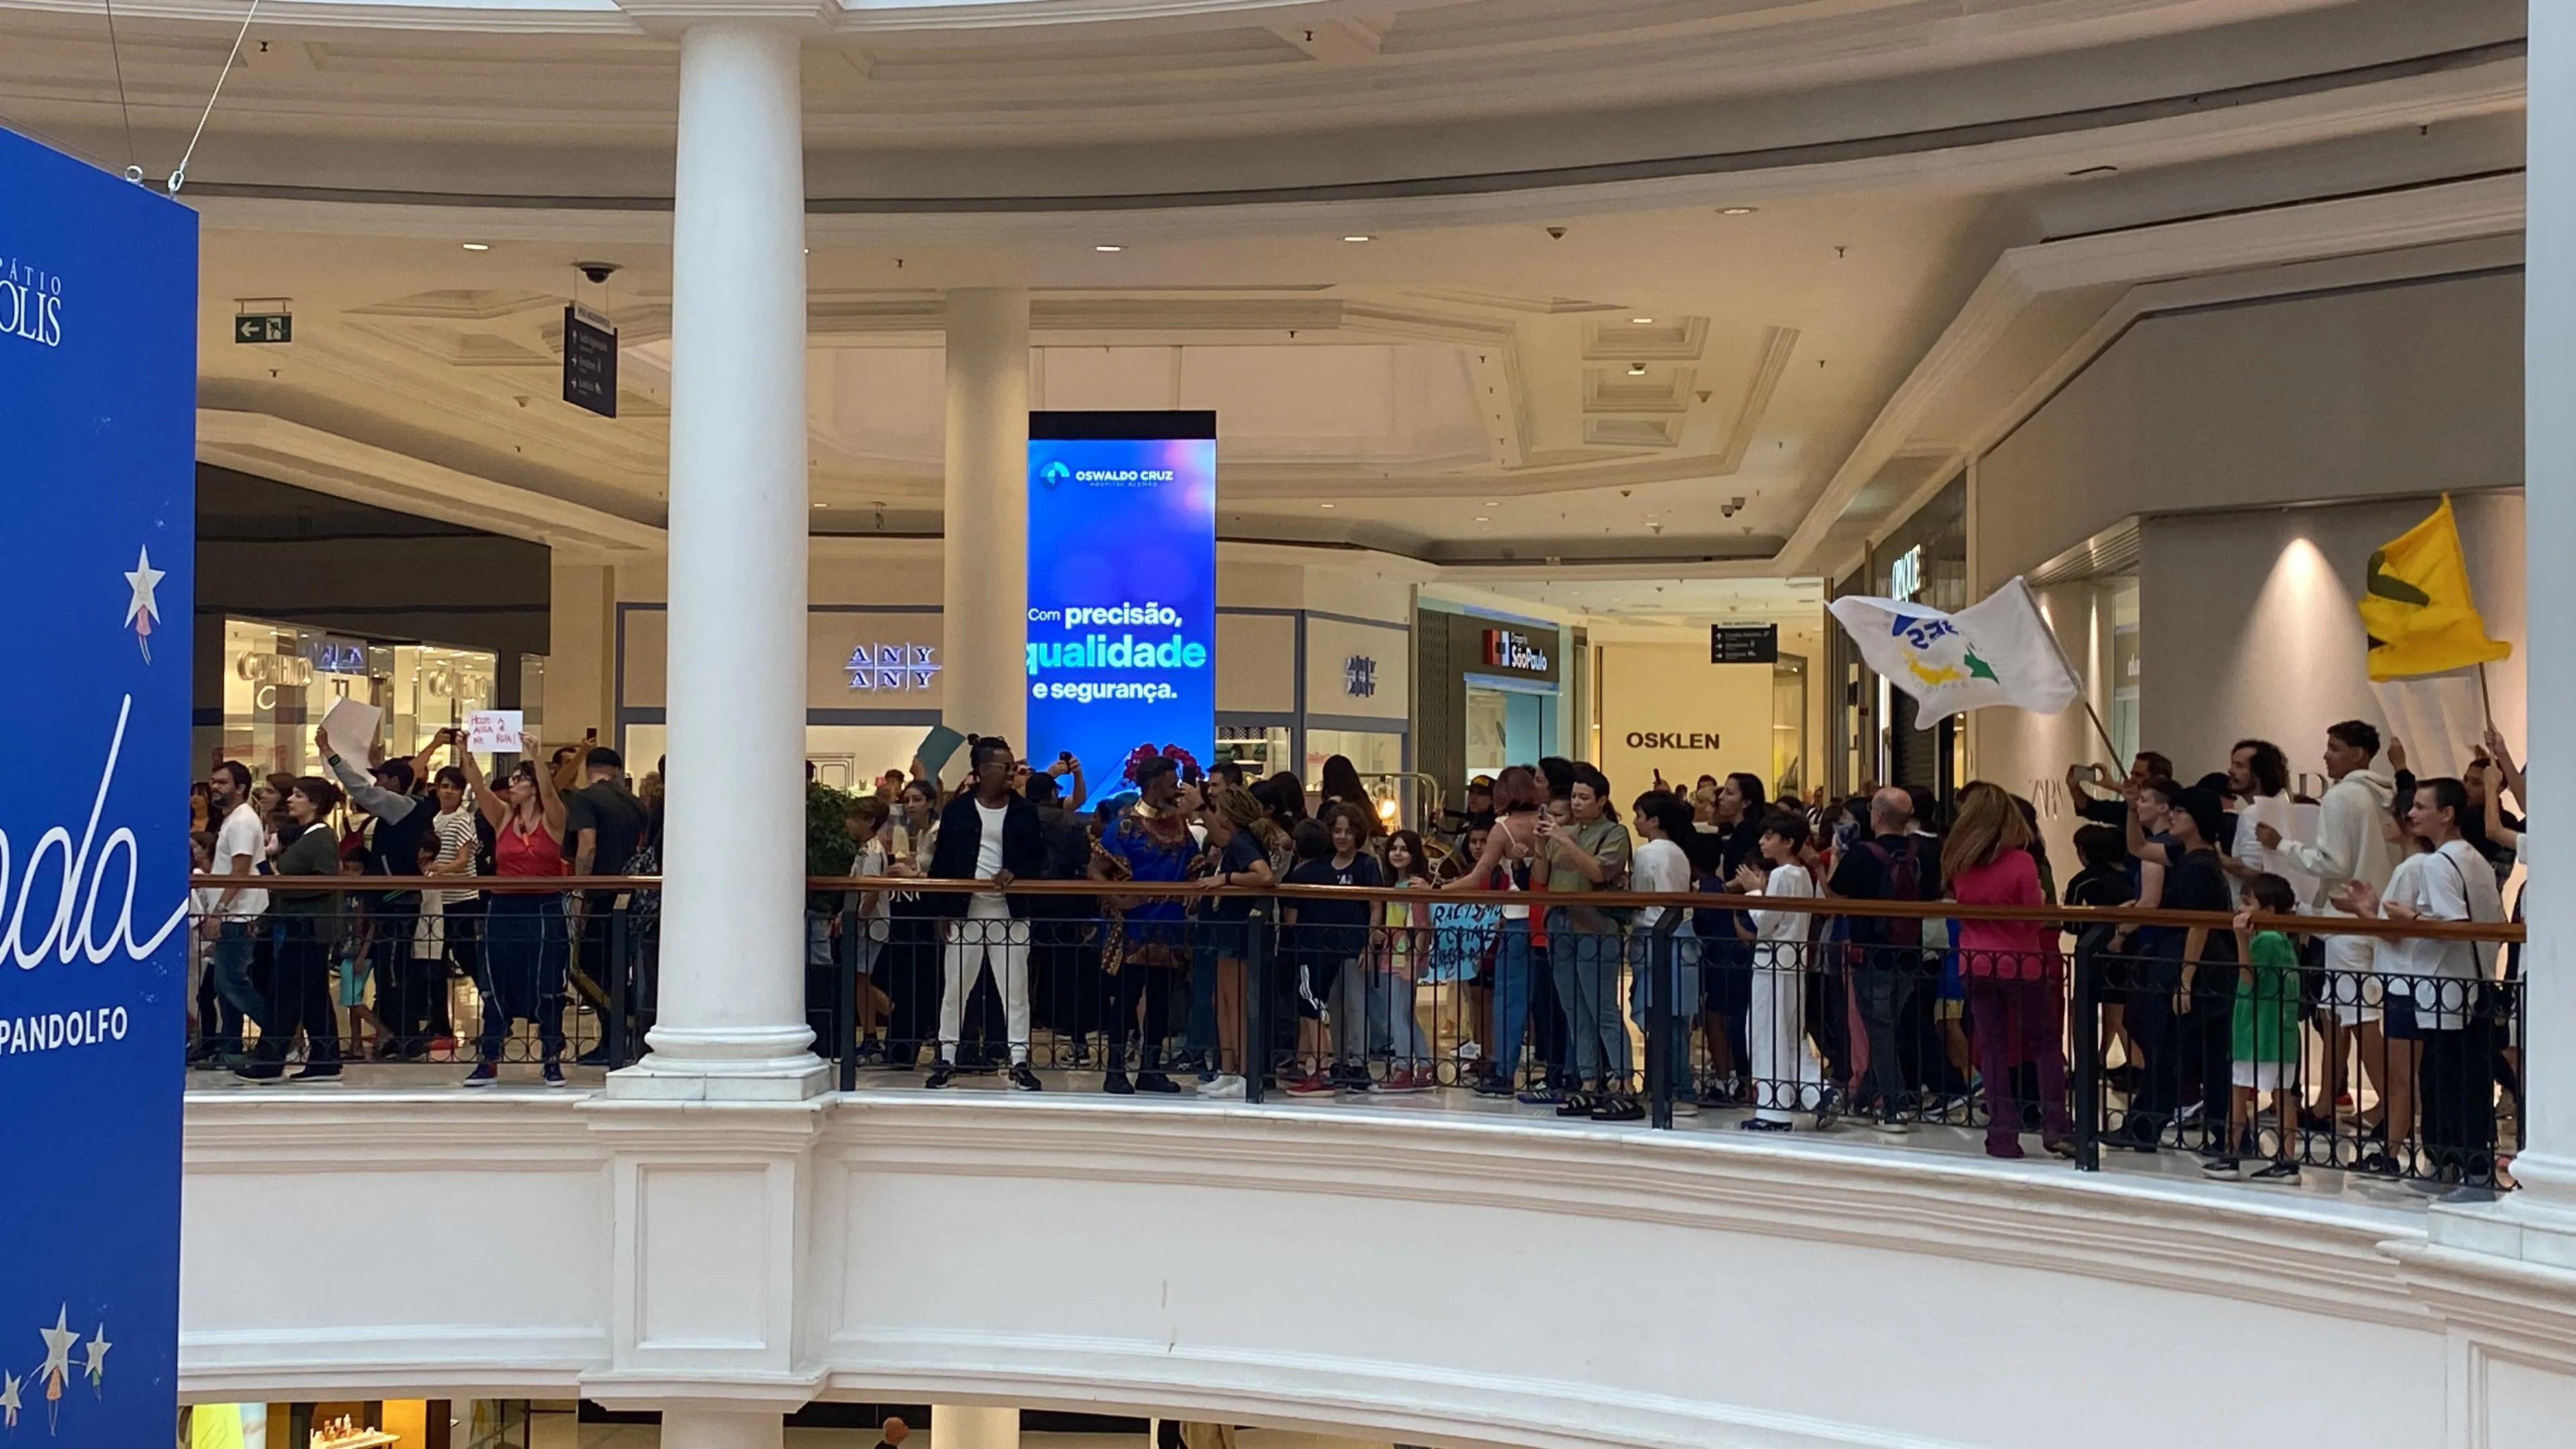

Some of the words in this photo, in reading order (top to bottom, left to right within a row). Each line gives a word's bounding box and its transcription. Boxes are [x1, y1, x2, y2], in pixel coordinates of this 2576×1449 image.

[0, 257, 61, 295] ÁTIO
[1075, 470, 1138, 481] OSWALDO
[1140, 470, 1174, 481] CRUZ
[1028, 608, 1061, 621] Com
[1065, 602, 1183, 629] precisão,
[1032, 683, 1048, 698] e
[1051, 683, 1177, 704] segurança.
[1626, 732, 1720, 749] OSKLEN
[1446, 923, 1497, 945] CIME
[0, 1006, 127, 1055] PANDOLFO
